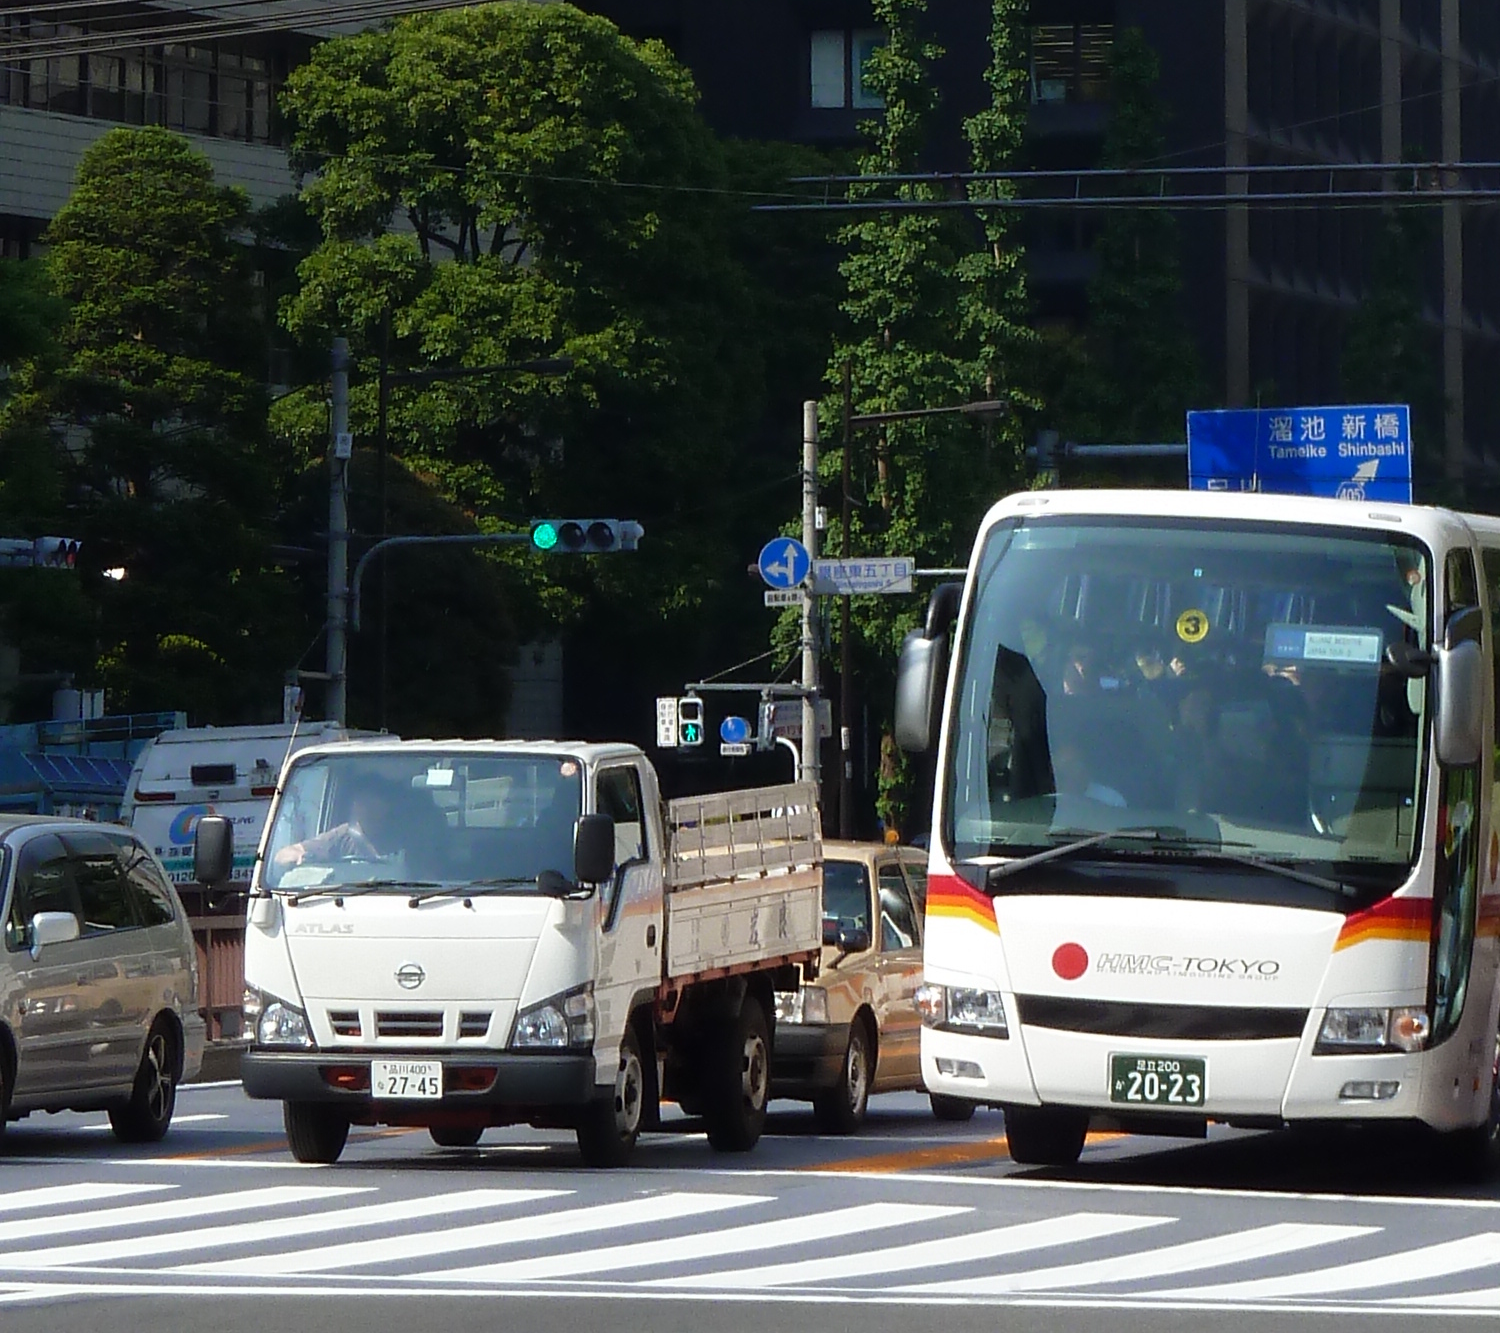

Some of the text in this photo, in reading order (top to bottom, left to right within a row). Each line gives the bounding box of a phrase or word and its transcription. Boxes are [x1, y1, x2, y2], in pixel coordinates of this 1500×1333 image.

[1268, 413, 1400, 443] 溜池 新橋
[1268, 441, 1405, 459] Tameike Shinbashi
[1184, 615, 1200, 635] 3
[294, 923, 354, 934] ATLAS
[1097, 953, 1280, 974] HMC-TOKYO
[389, 1064, 427, 1075] 品川400
[388, 1077, 438, 1095] 27-45
[1127, 1072, 1200, 1103] 20-23
